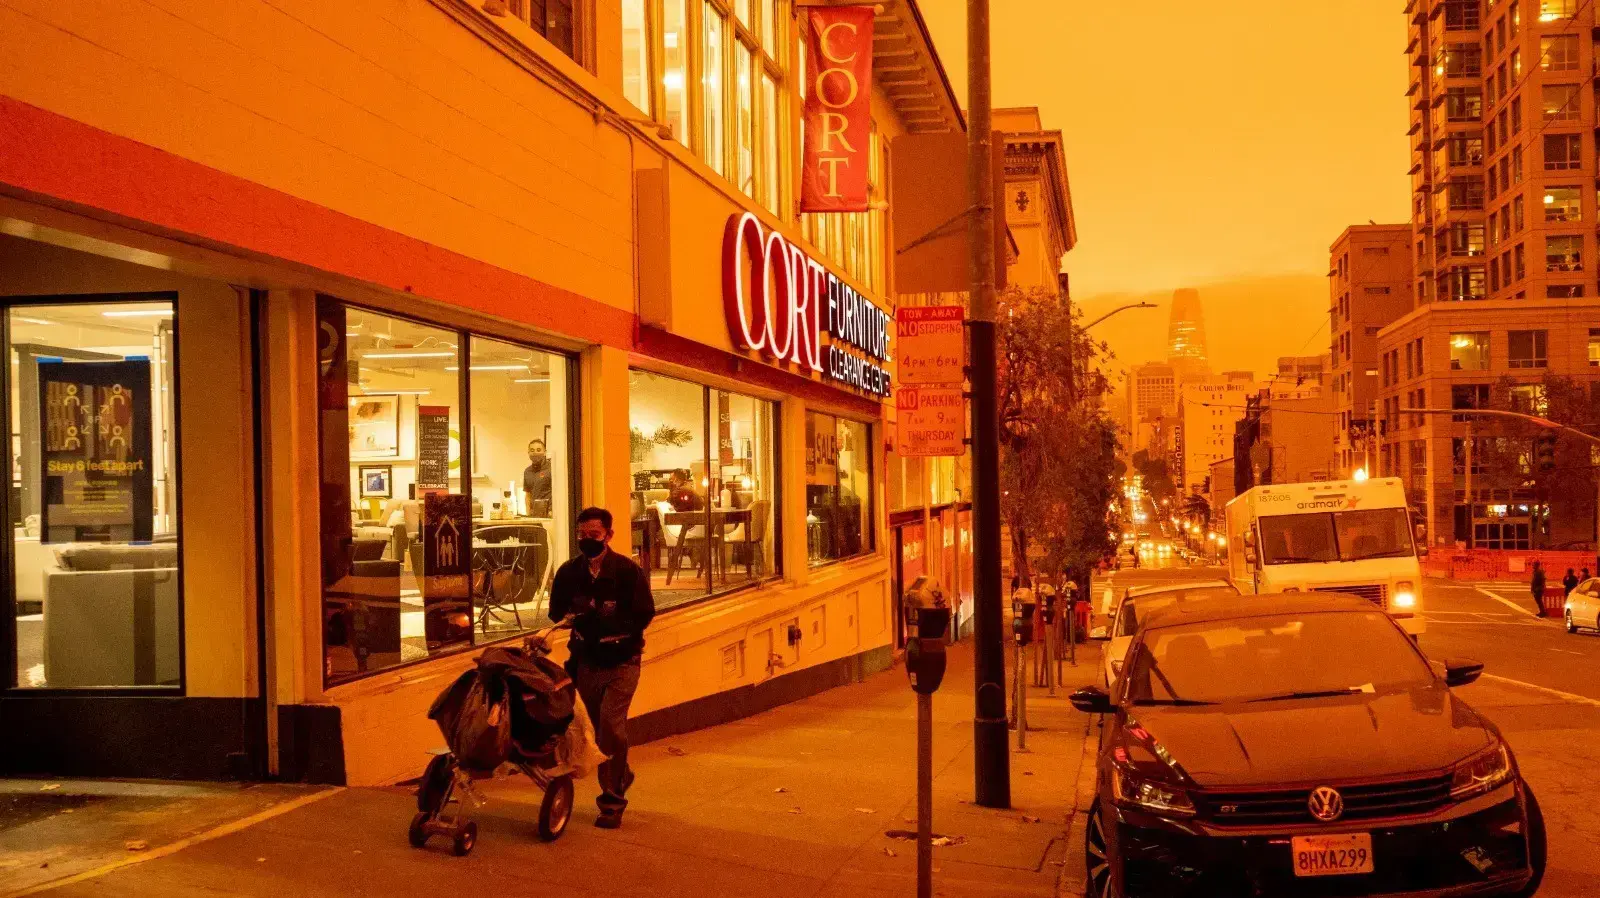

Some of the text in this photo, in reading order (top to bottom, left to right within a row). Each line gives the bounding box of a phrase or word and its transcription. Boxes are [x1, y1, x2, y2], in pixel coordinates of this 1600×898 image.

[815, 22, 858, 197] CORT
[733, 211, 827, 373] CORT
[828, 272, 891, 362] FURNITURE
[903, 309, 922, 318] TOW
[931, 308, 958, 318] AWAY
[898, 320, 961, 336] NO STOPPING
[830, 344, 871, 390] CLEARANCE
[898, 390, 961, 408] NO PARKING
[907, 430, 956, 441] THURSDAY
[816, 432, 835, 466] SALE
[48, 460, 144, 474] Stay 6 feet apart
[1259, 494, 1291, 502] 187605
[1296, 499, 1343, 509] aramark
[1299, 848, 1367, 870] 8HXA299
